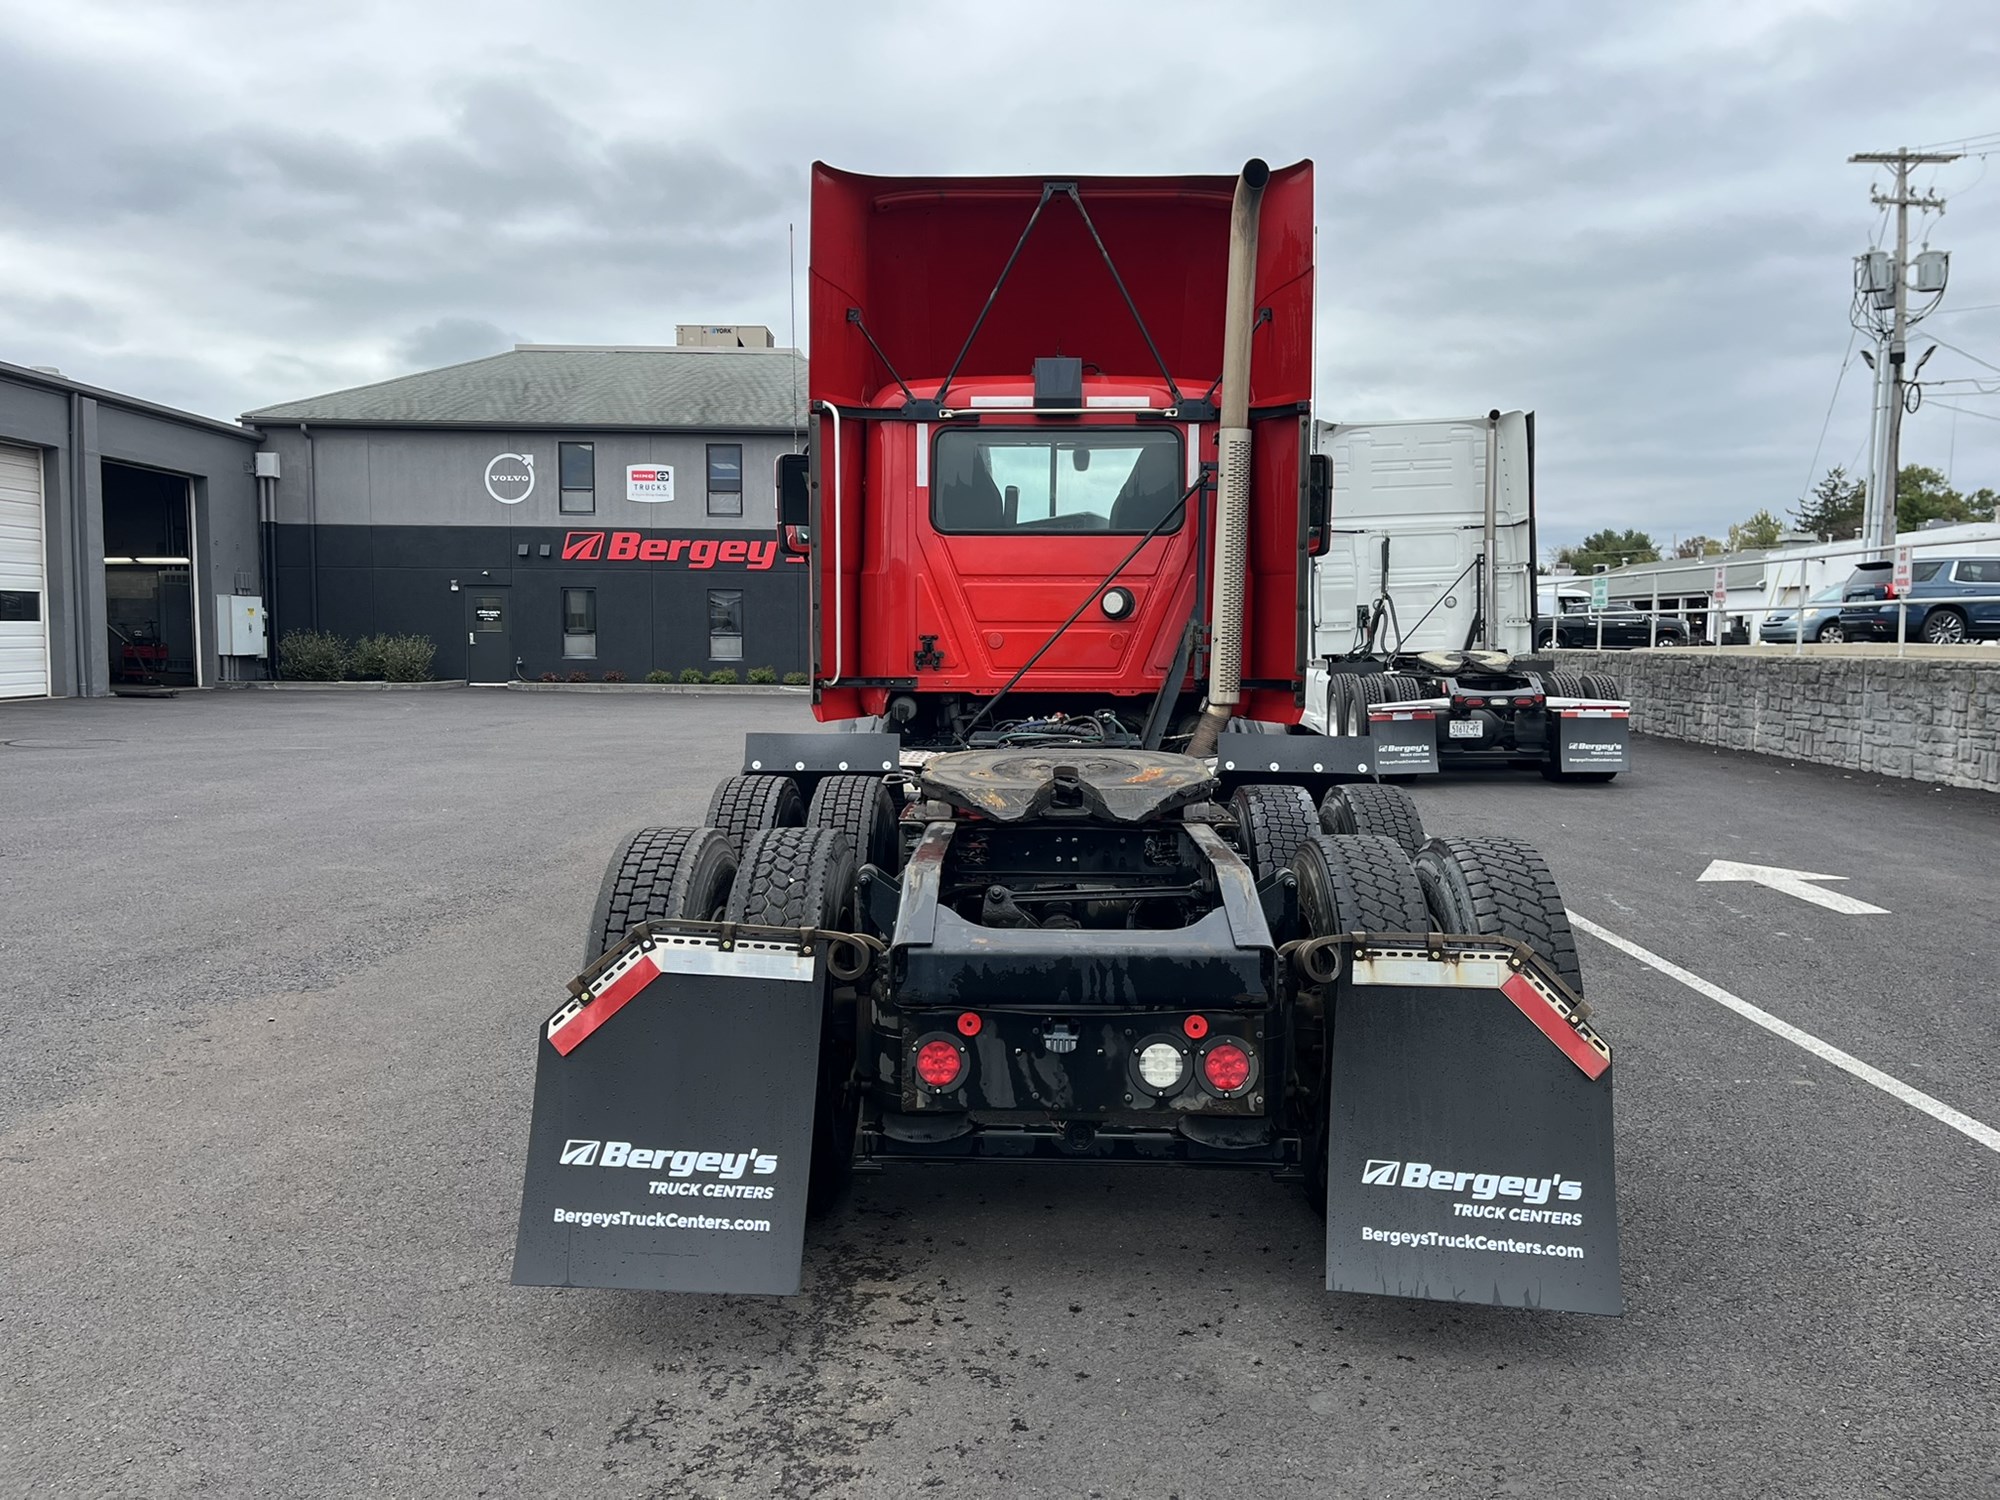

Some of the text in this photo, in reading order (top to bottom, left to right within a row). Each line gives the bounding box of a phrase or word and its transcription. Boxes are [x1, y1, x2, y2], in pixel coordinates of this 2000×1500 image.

[607, 531, 805, 569] Bergey
[1388, 744, 1429, 753] Bergey's
[1579, 743, 1622, 751] Bergey's
[599, 1141, 778, 1179] Bergey's
[649, 1181, 775, 1199] TRUCK CENTERS
[1401, 1162, 1582, 1205] Bergey's
[553, 1208, 771, 1232] BergeysTruckCenters.com
[1453, 1203, 1583, 1226] TRUCK CENTERS
[1362, 1226, 1584, 1259] BergeysTruckCenters.com
